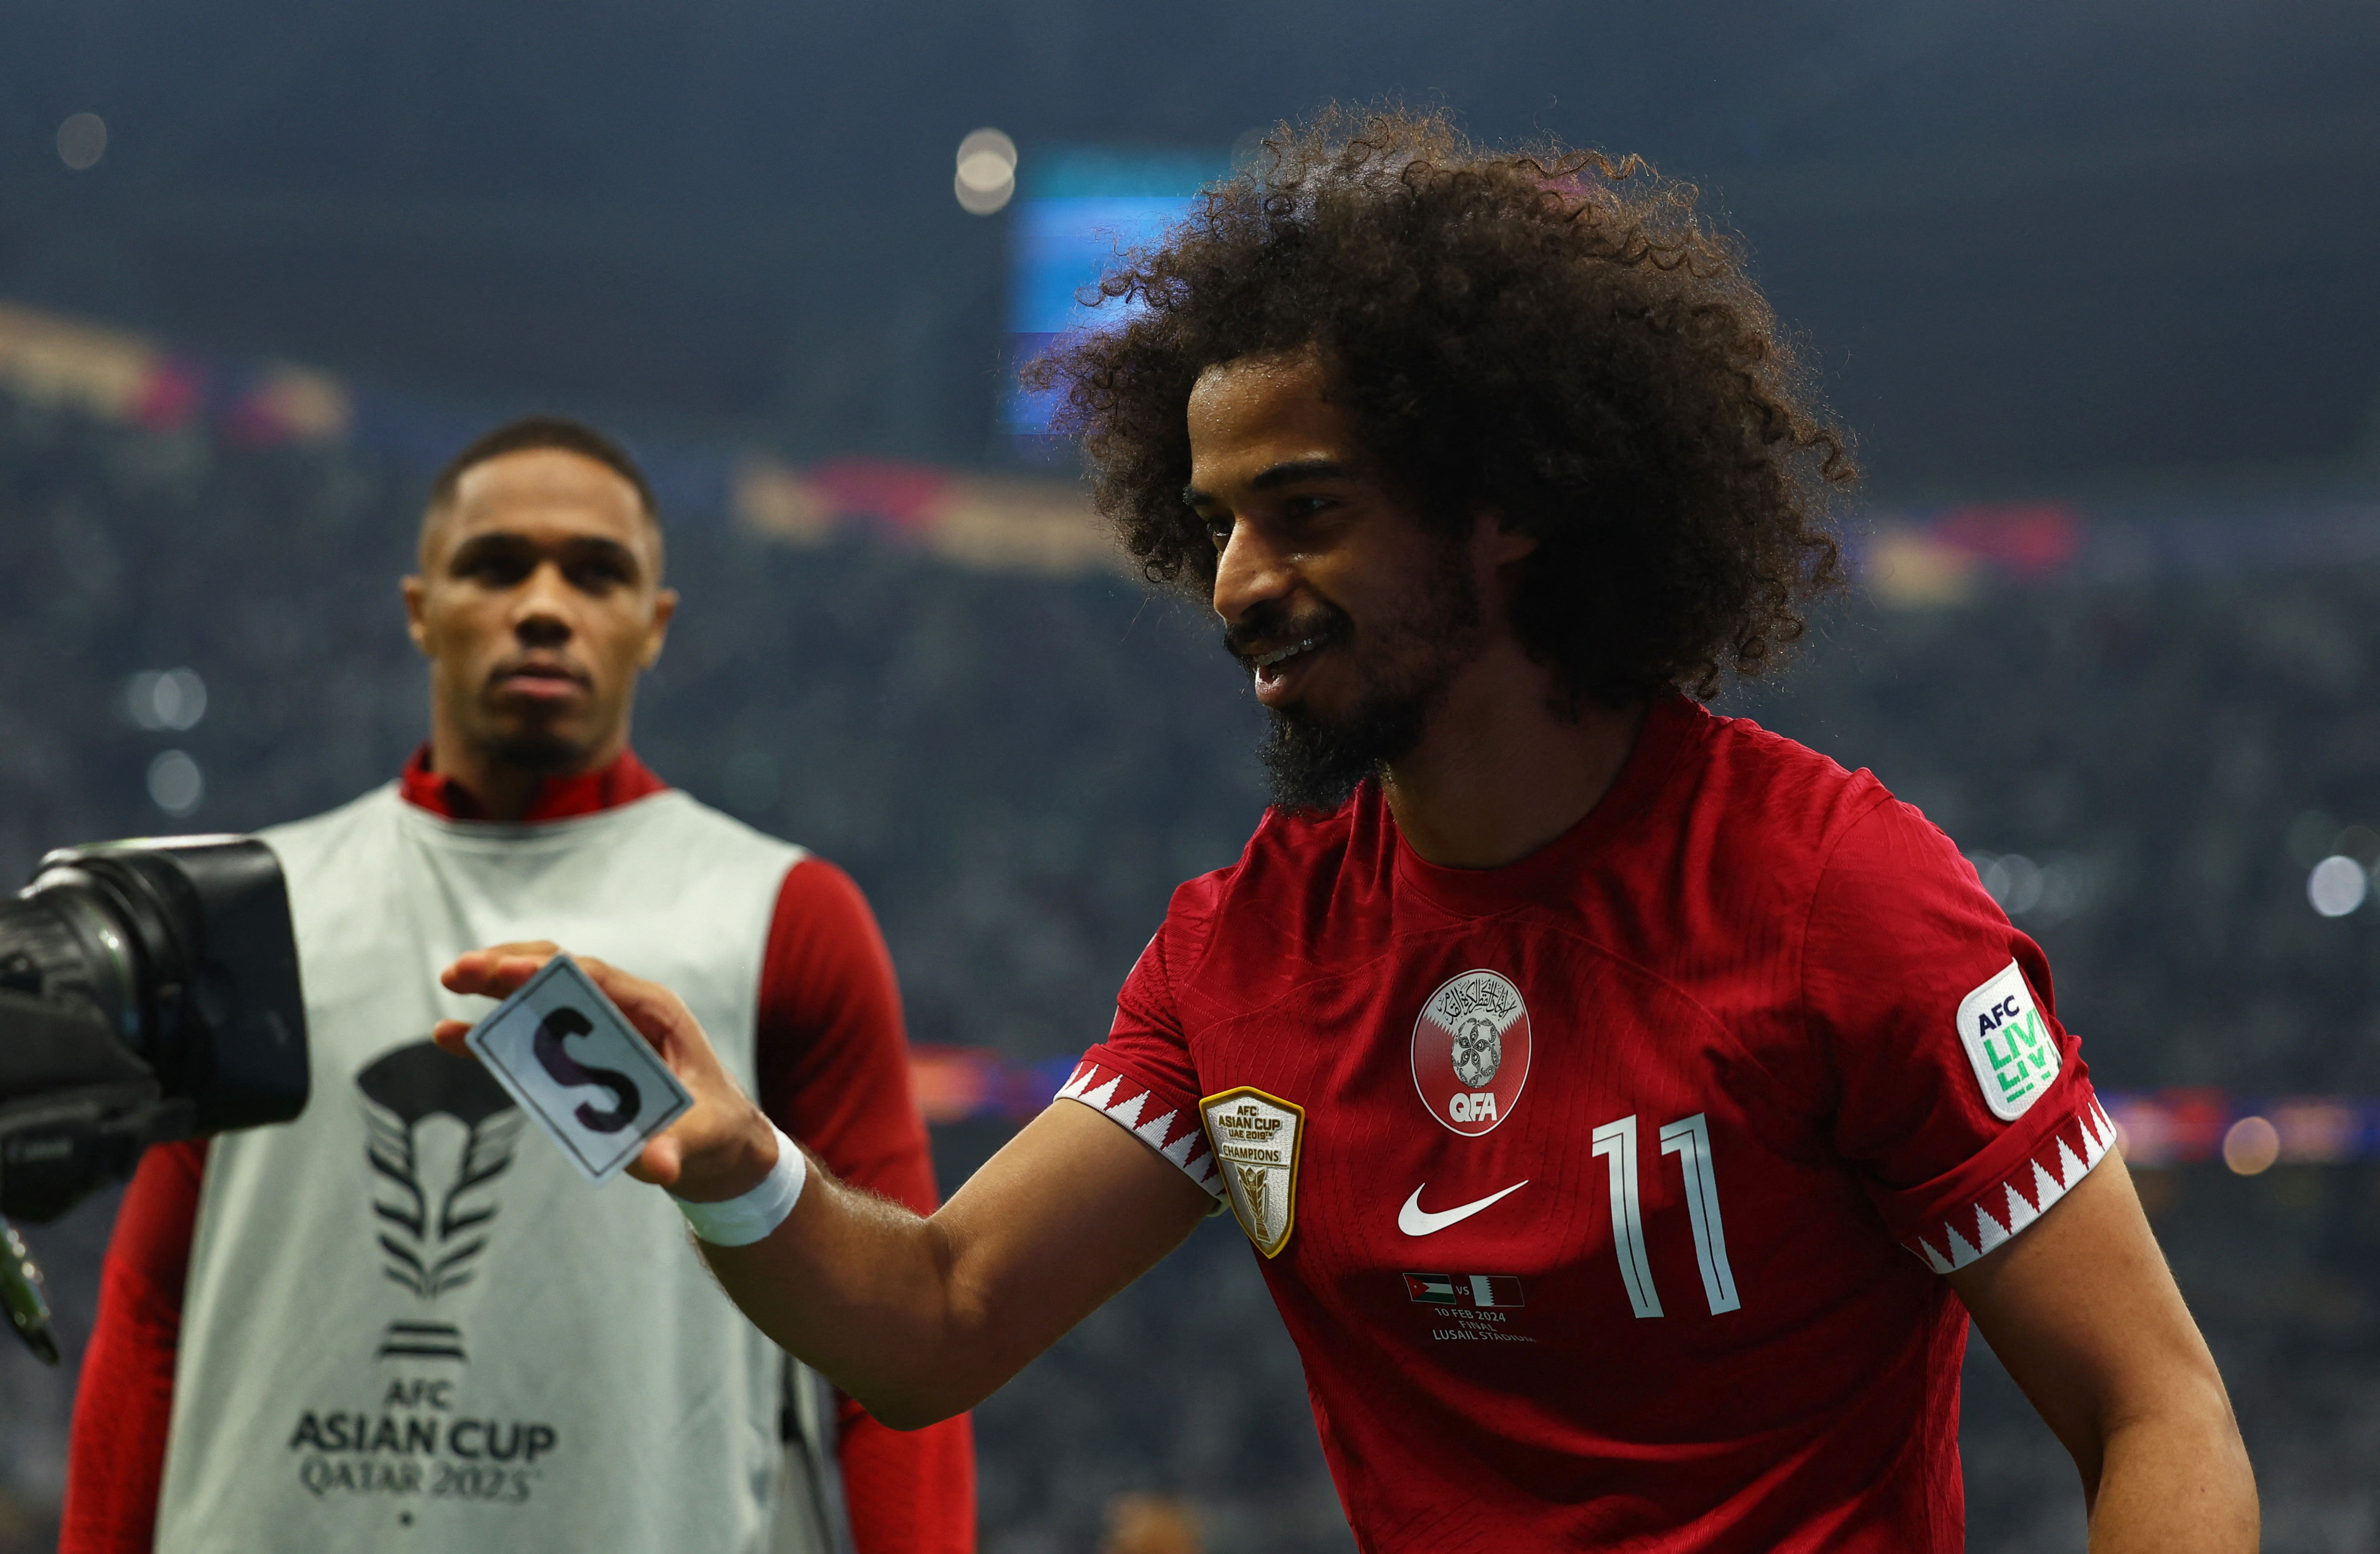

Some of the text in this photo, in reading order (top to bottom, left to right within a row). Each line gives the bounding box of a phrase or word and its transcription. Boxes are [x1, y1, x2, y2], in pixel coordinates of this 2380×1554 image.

[1979, 995, 2020, 1037] AFC
[1983, 1008, 2046, 1071] LIV
[533, 1005, 641, 1134] S
[1237, 1105, 1257, 1117] AFC
[1449, 1092, 1497, 1122] QFA
[1218, 1116, 1281, 1131] ASIAN CUP
[1229, 1130, 1244, 1138] UAE
[1223, 1145, 1279, 1162] CHAMPIONS
[1592, 1112, 1741, 1319] 11
[1455, 1286, 1470, 1295] VS
[1435, 1308, 1506, 1322] 10 FEB 2024
[1459, 1320, 1497, 1332] FINAL
[1432, 1329, 1478, 1340] LUSAIL
[384, 1378, 454, 1410] AFC
[290, 1410, 558, 1462] ASIAN CUP
[301, 1455, 423, 1497] QATAR
